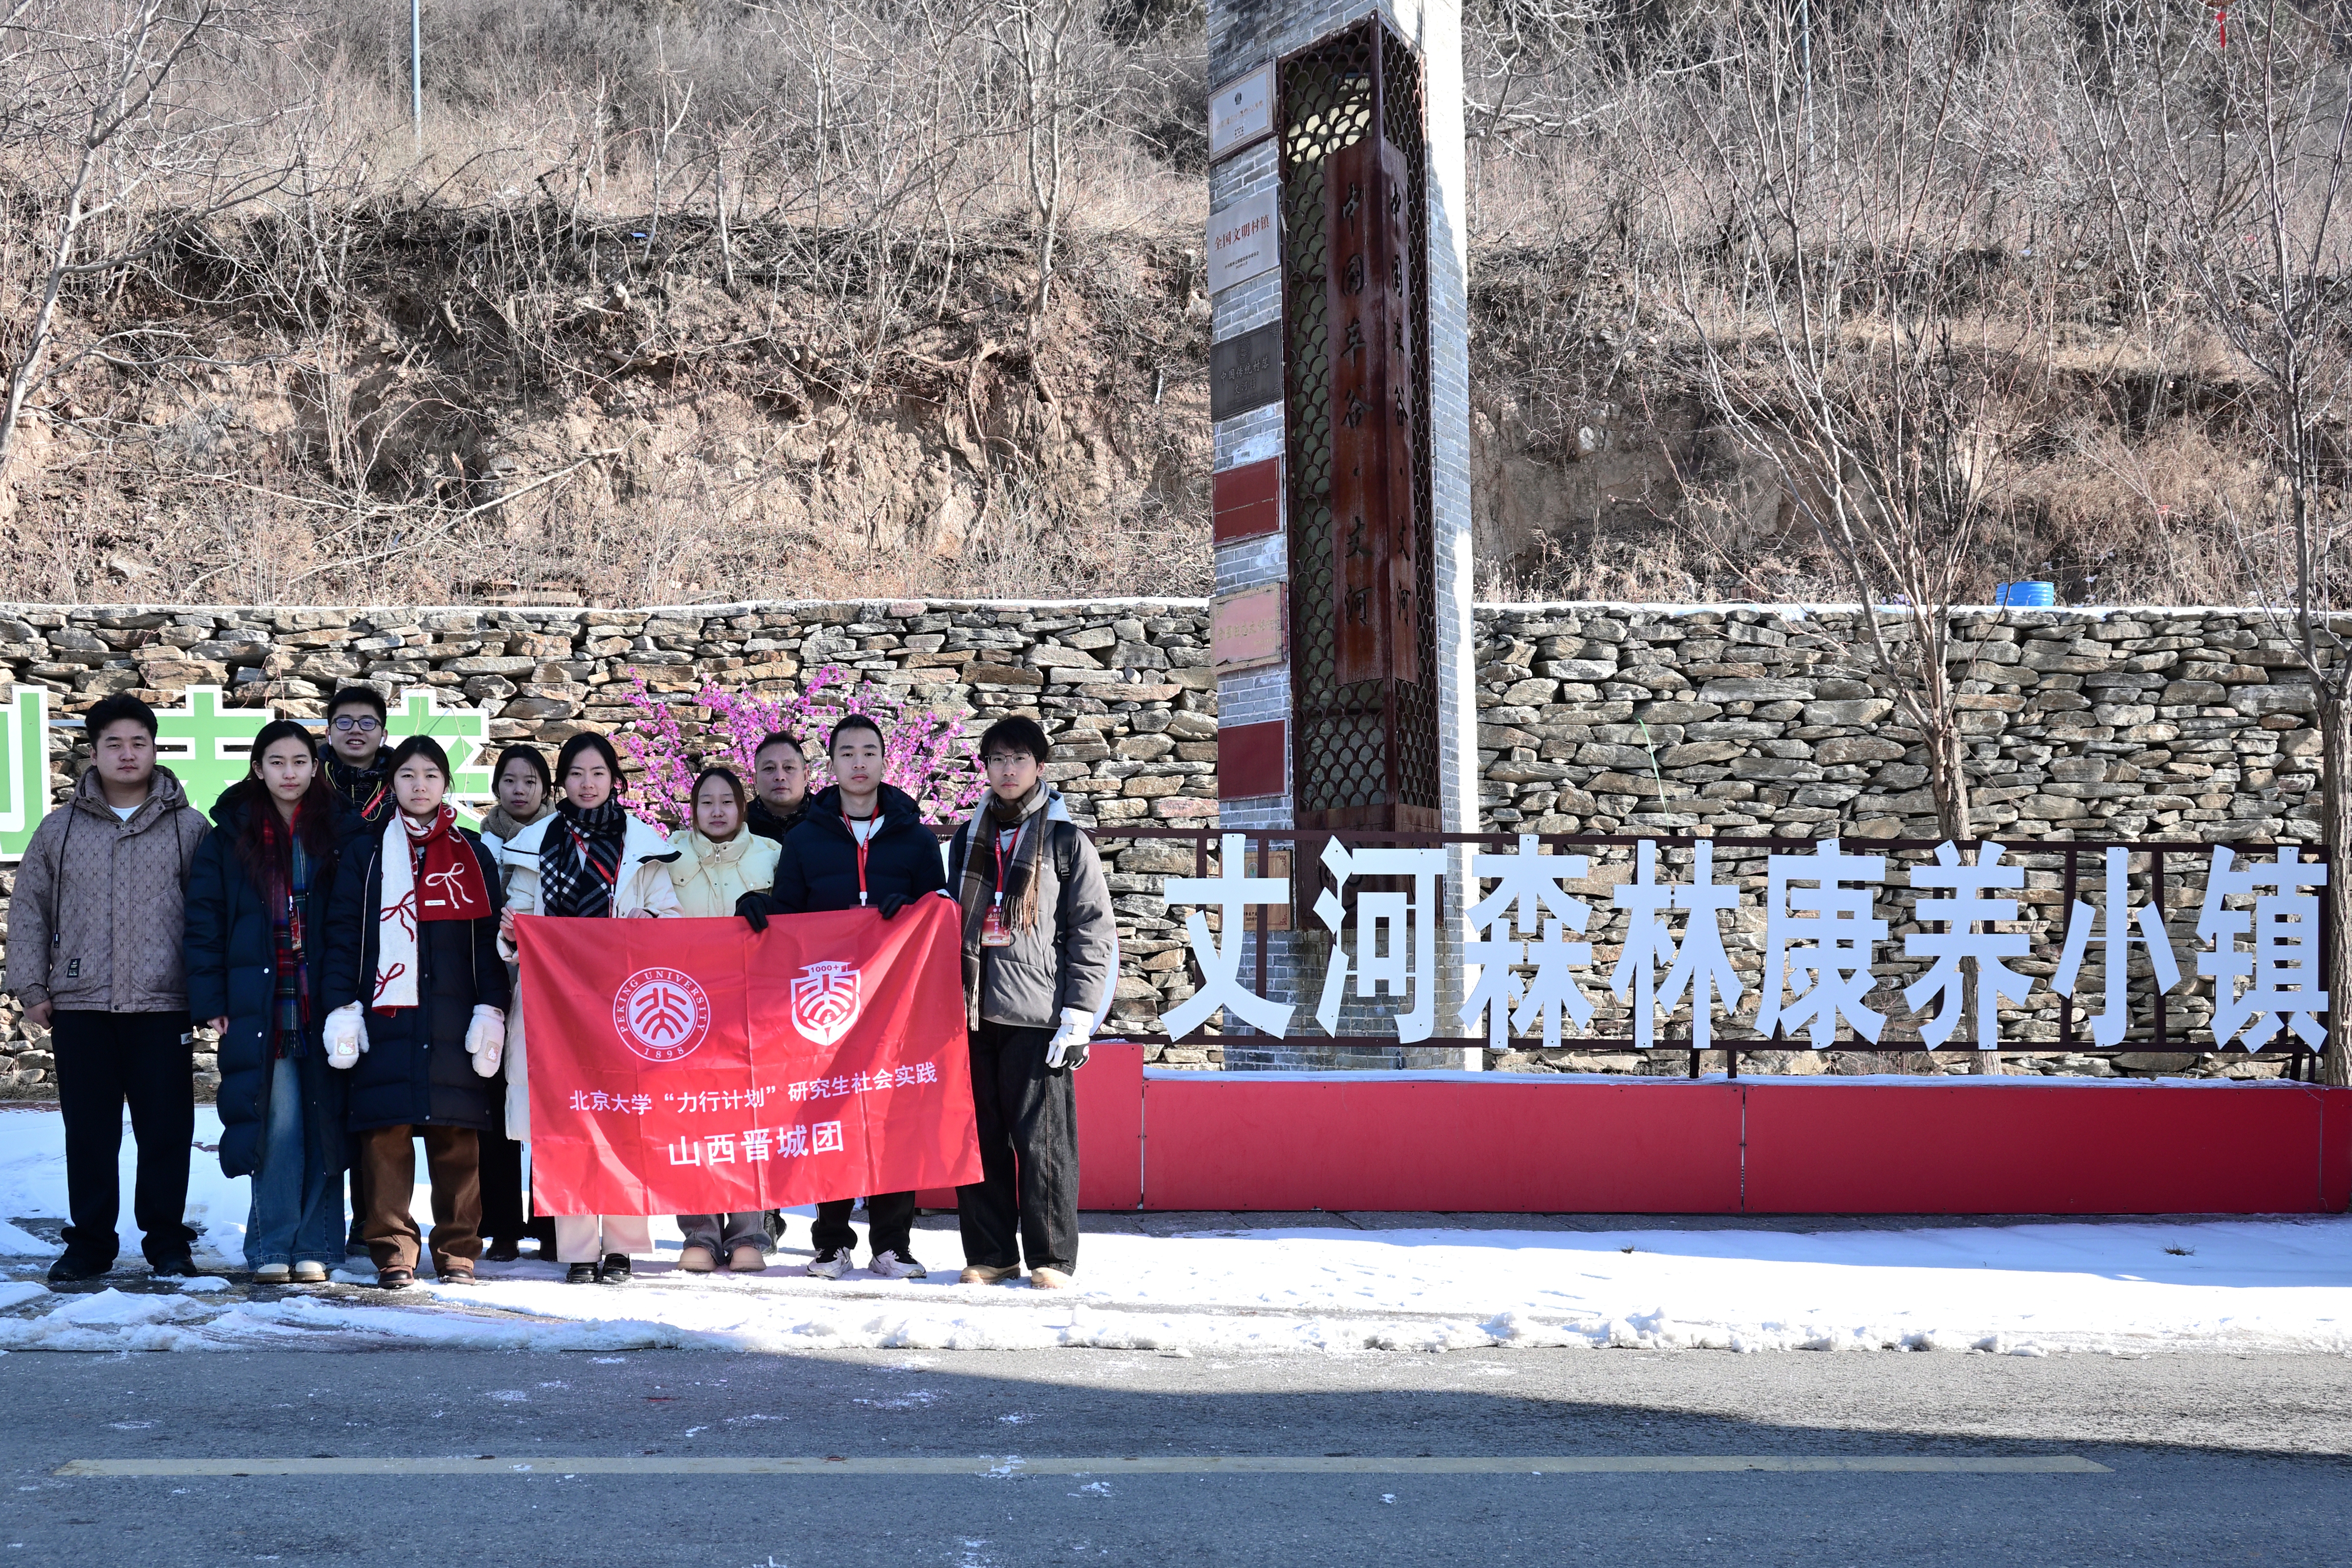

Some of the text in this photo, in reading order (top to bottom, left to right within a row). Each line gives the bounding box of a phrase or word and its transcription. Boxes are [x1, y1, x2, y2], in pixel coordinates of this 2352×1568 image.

[1214, 214, 1269, 251] 全国文明村镇
[1220, 356, 1269, 385] 中国传统村落
[1234, 378, 1256, 394] 丈河村
[1159, 833, 2329, 1054] 丈河森林康养小镇
[811, 964, 839, 973] 1000+
[617, 971, 707, 1033] PEKING UNIVERSITY
[643, 1046, 685, 1059] 1898
[668, 1120, 844, 1166] 山西晋城团
